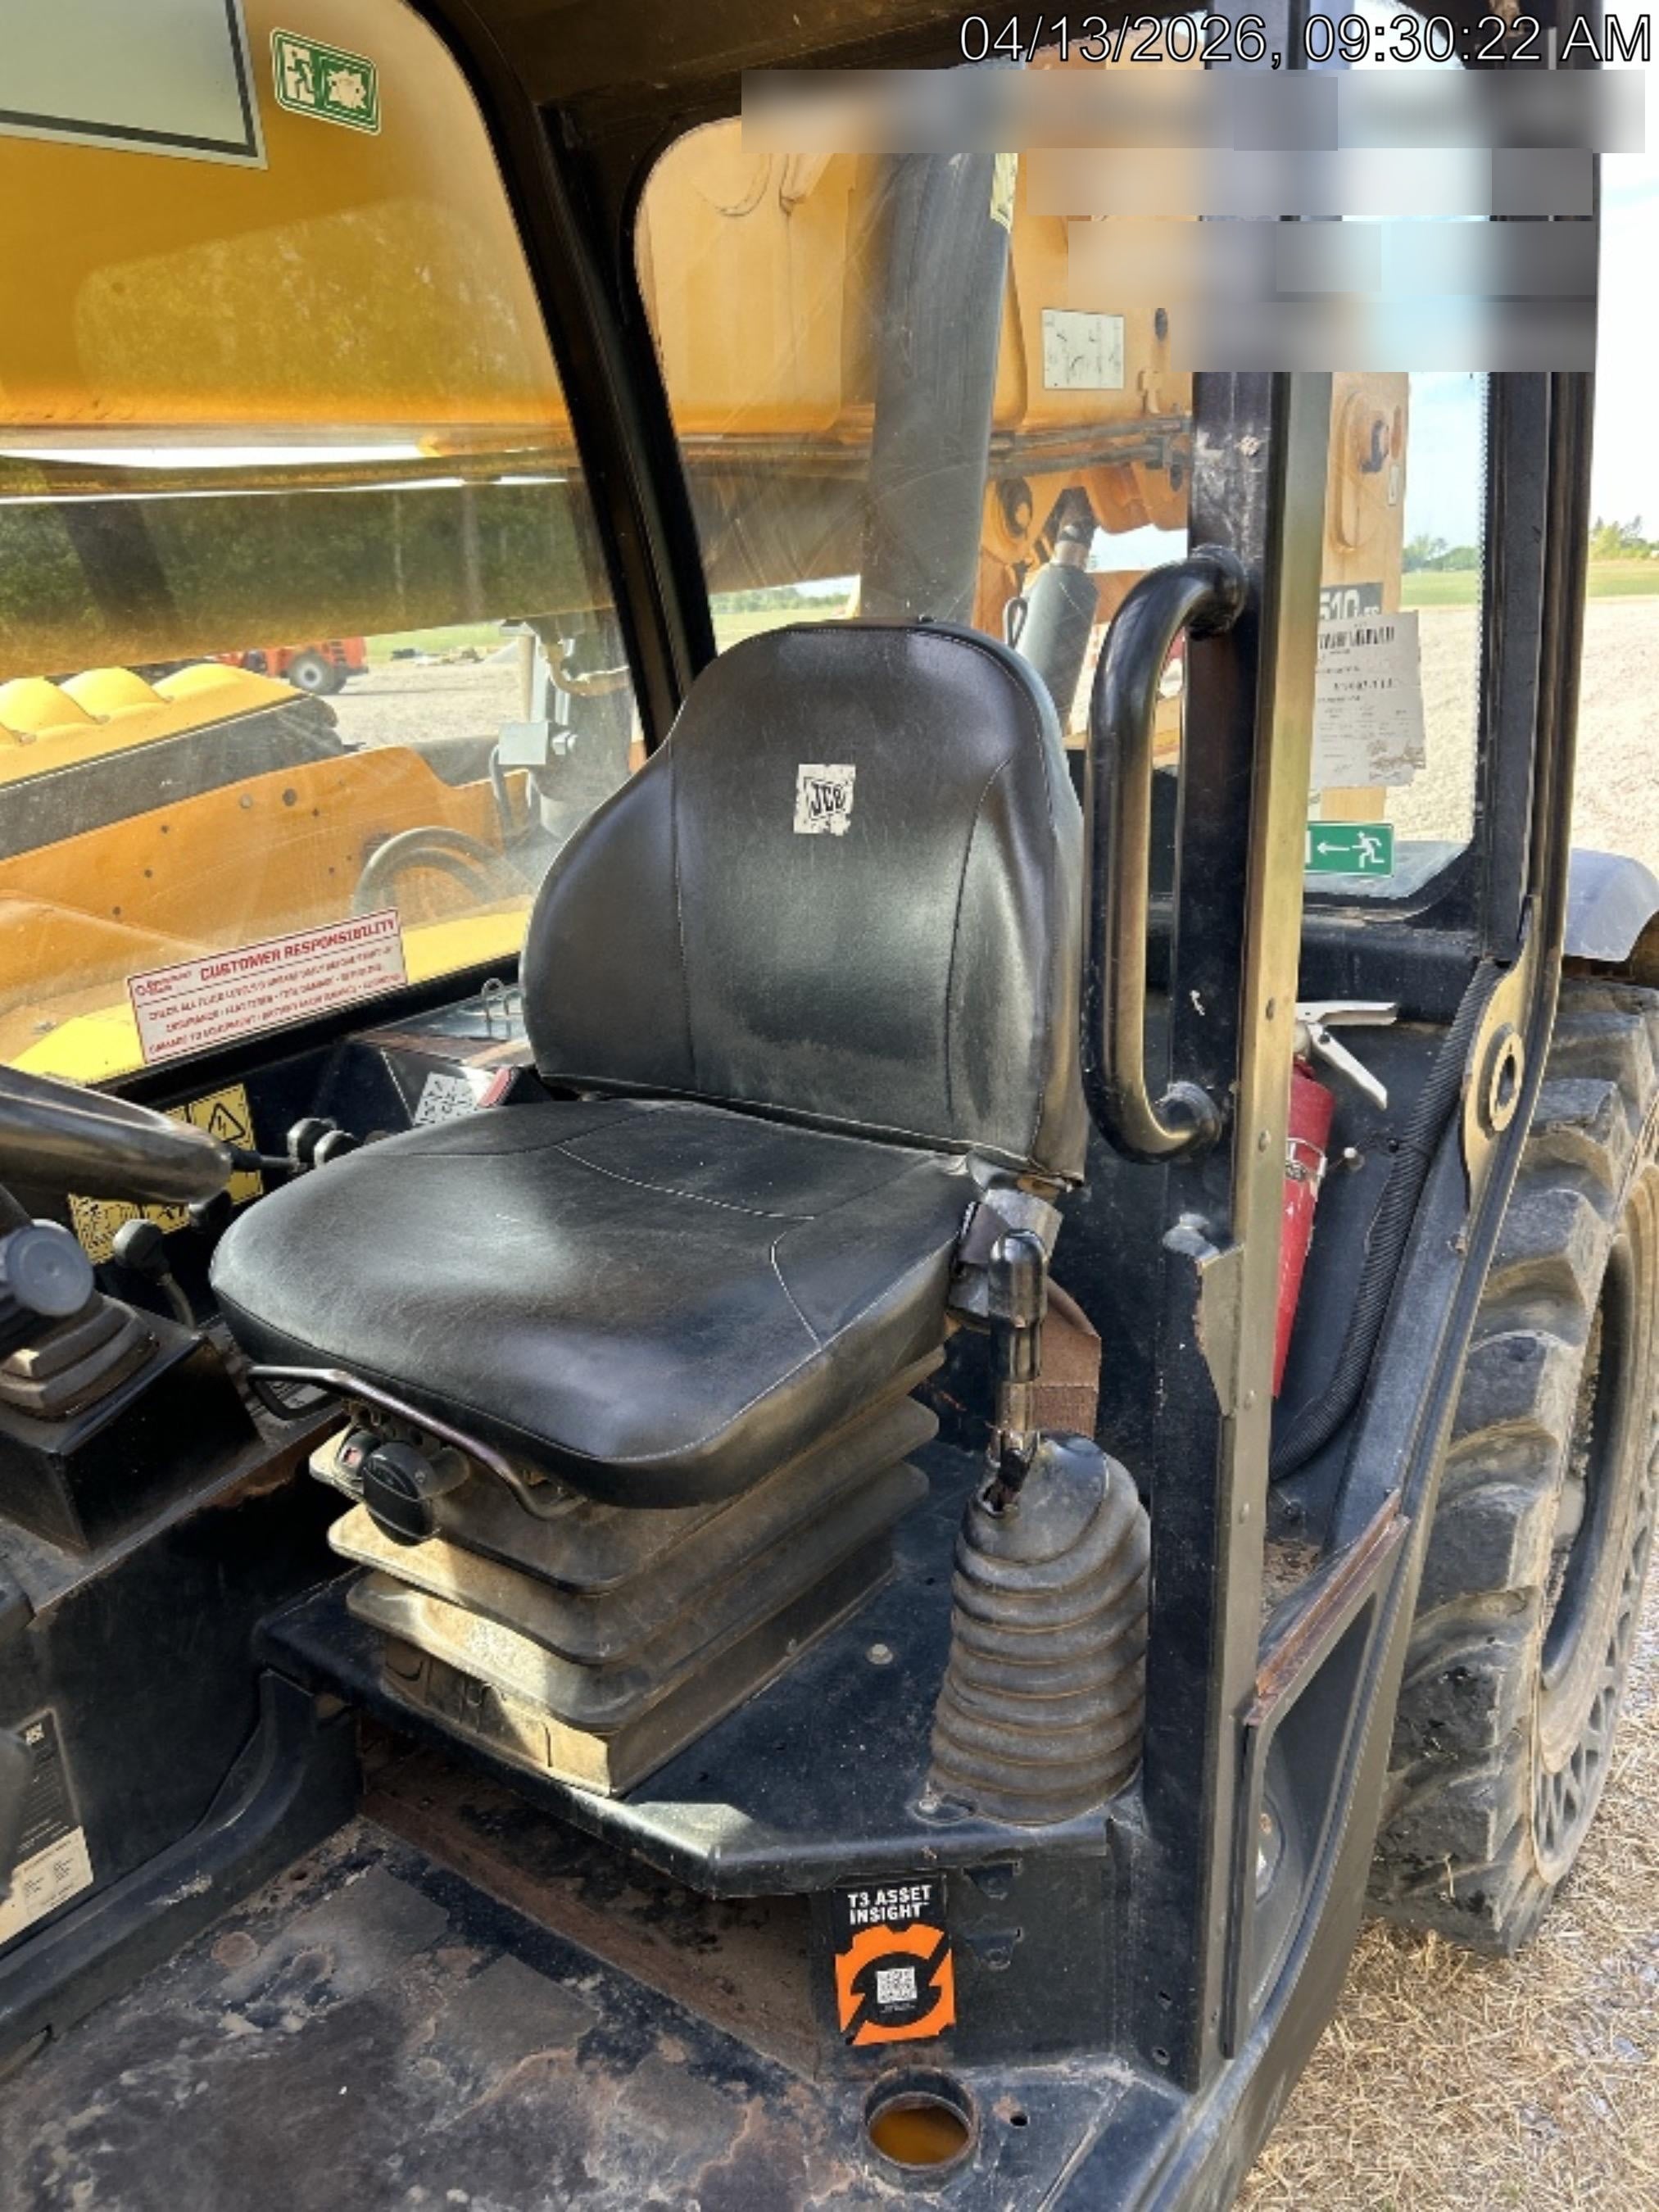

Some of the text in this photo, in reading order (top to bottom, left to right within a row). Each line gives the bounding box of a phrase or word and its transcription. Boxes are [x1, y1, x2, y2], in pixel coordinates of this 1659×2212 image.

[810, 781, 847, 816] JCB
[201, 950, 280, 981] CUSTOMER
[284, 918, 394, 959] RESPONSIBILITY
[847, 1884, 932, 1909] T3 ASSET
[850, 1903, 923, 1925] INSIGHT
